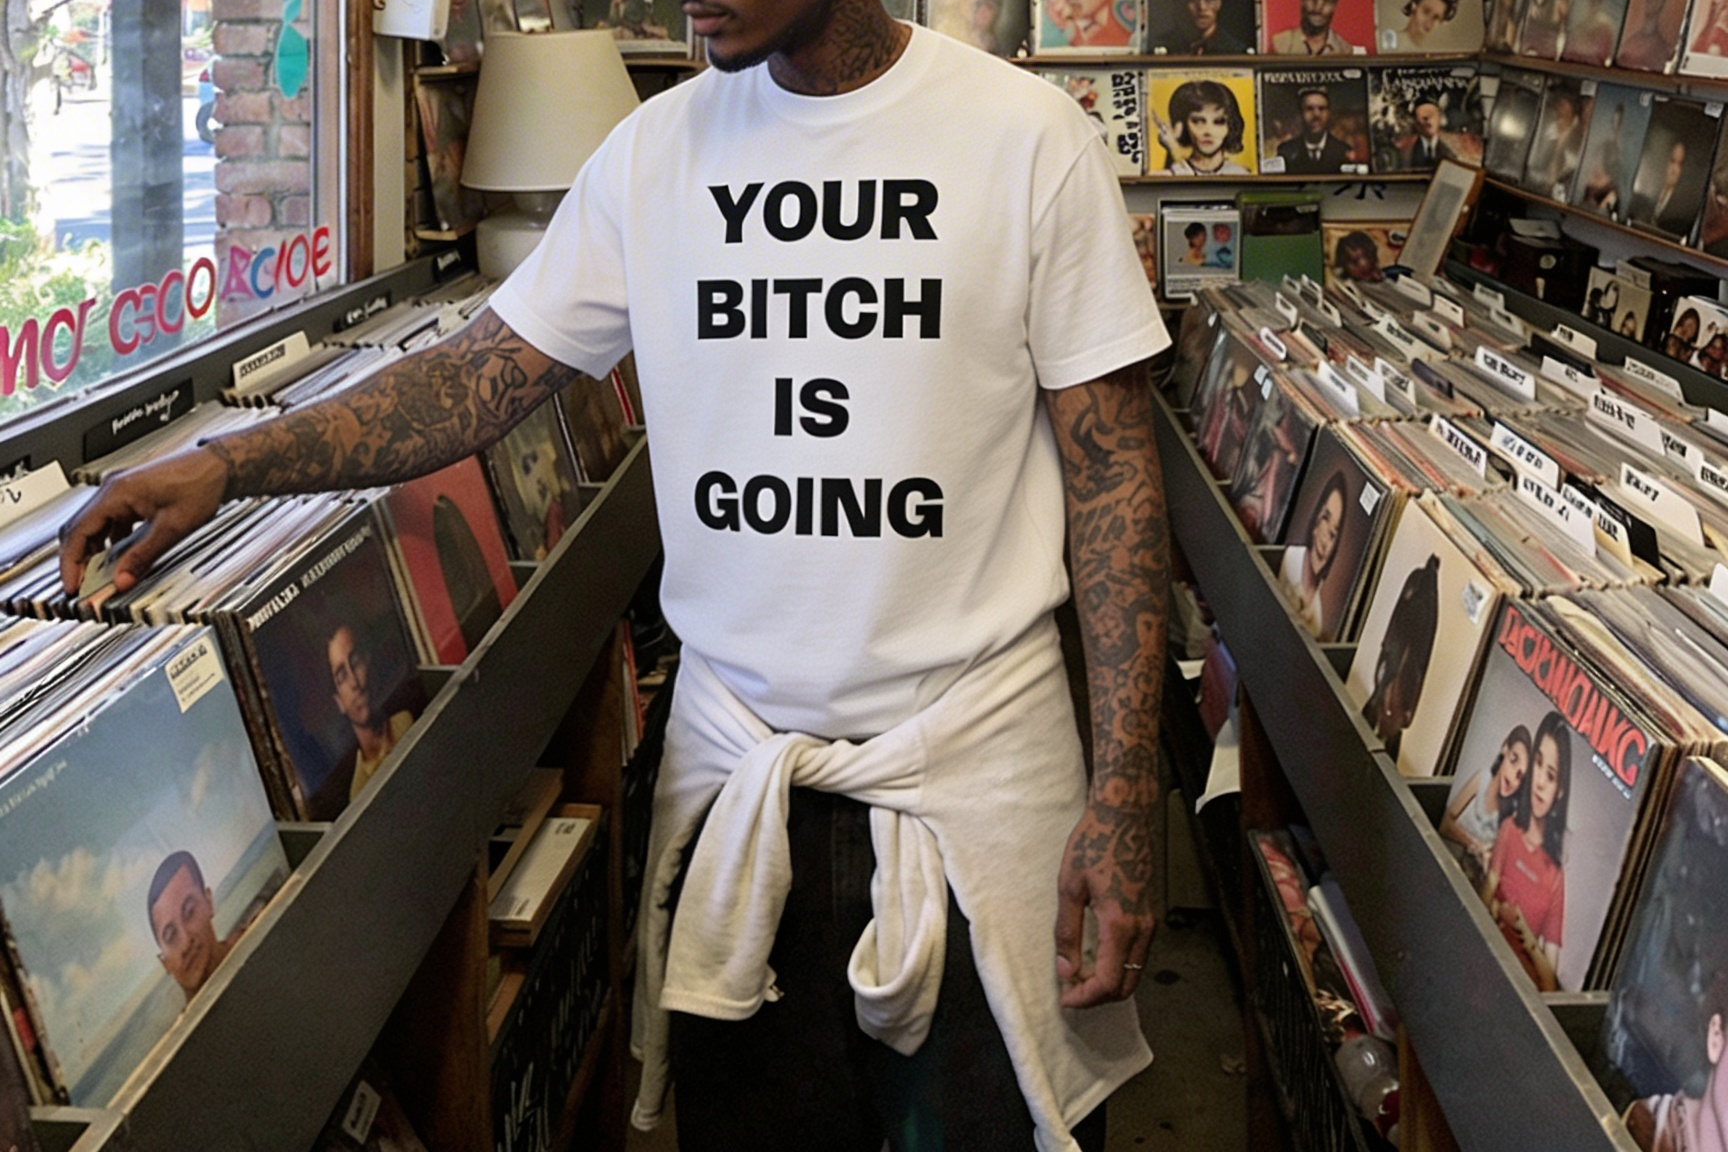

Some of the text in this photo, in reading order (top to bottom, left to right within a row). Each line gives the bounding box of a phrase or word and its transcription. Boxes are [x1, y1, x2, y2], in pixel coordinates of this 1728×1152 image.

[708, 179, 939, 244] YOUR
[697, 277, 943, 340] BITCH
[774, 377, 850, 438] IS
[694, 470, 944, 539] GOING
